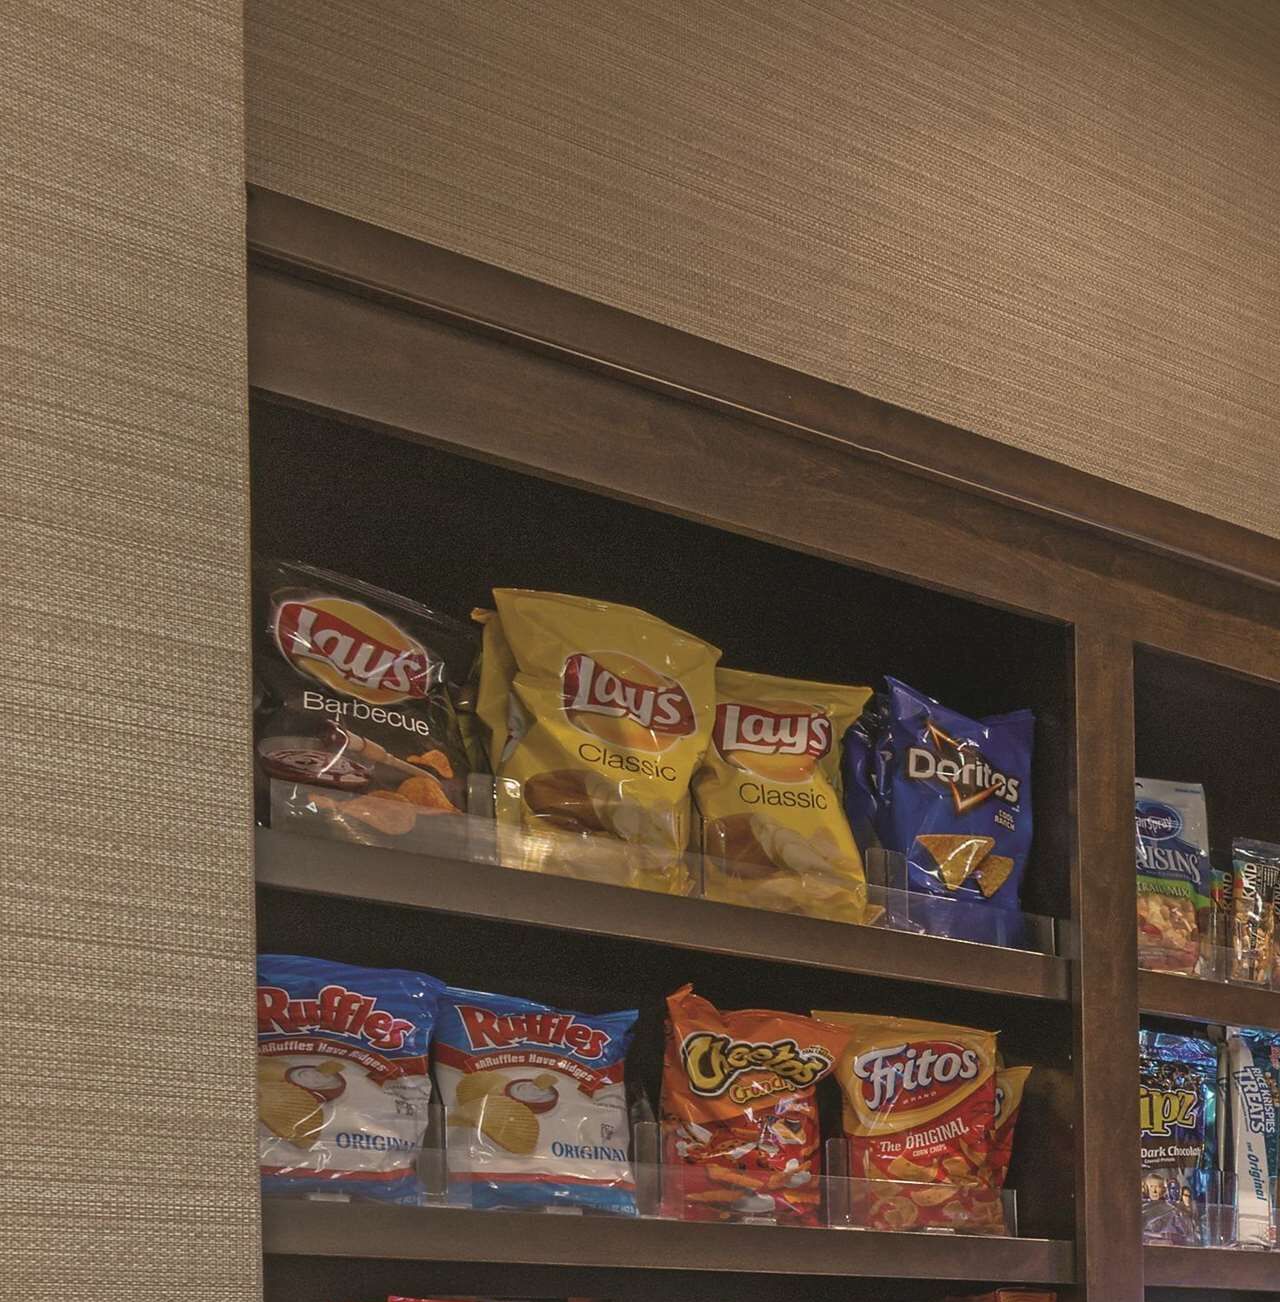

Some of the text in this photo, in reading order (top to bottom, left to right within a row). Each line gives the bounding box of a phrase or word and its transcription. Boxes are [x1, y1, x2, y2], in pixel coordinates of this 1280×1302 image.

[303, 691, 430, 736] Barbecue
[570, 655, 684, 728] Lay's
[722, 704, 830, 757] Lay's
[578, 742, 677, 782] Classic
[908, 747, 1020, 802] Doritos
[738, 782, 828, 810] Classic
[1242, 862, 1259, 901] KIND
[257, 985, 416, 1050] Ruffles
[455, 1005, 611, 1060] Ruffles
[318, 1042, 347, 1055] Have
[528, 1053, 557, 1066] Have
[684, 1033, 828, 1092] Cheetos
[854, 1040, 979, 1111] Fritos
[1234, 1068, 1264, 1135] TREATS
[1251, 1066, 1276, 1134] RICE KRISPIES
[880, 1117, 970, 1152] The ORIGINAL
[1141, 1146, 1167, 1158] Dark
[1247, 1153, 1267, 1204] Original
